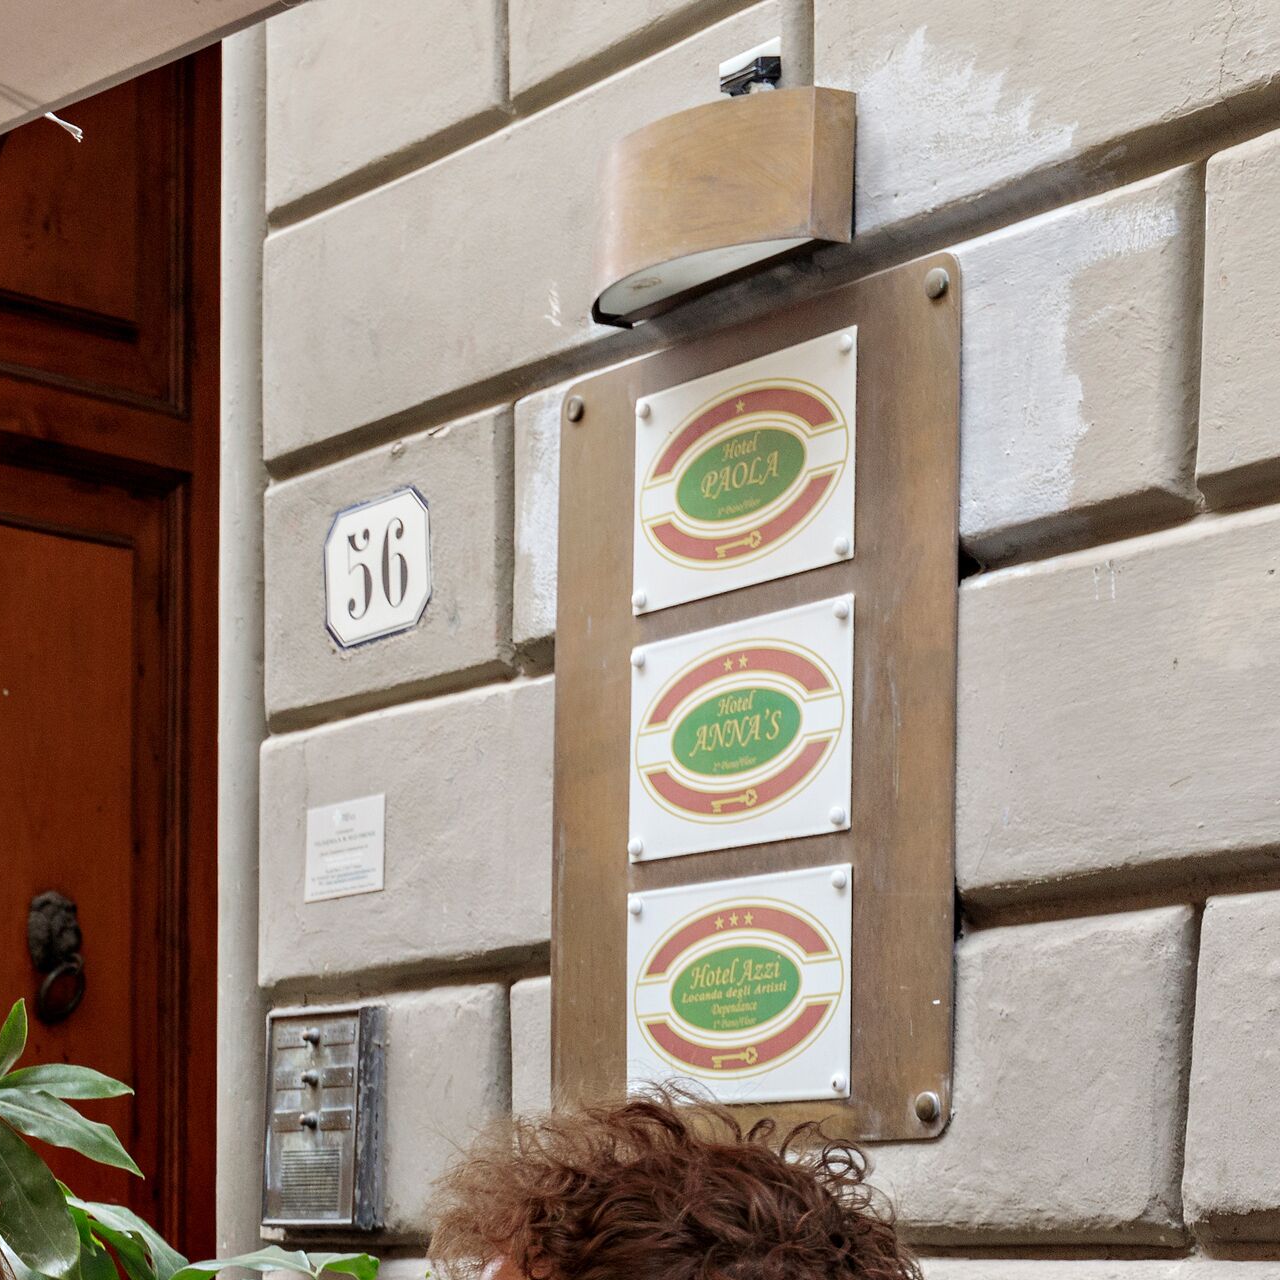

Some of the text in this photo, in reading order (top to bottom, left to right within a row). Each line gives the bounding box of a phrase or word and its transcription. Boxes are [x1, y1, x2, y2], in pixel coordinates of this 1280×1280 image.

[721, 431, 760, 462] Hotel
[701, 450, 779, 500] PAOLA
[347, 517, 408, 620] 56
[717, 689, 757, 717] Hotel
[689, 708, 782, 758] ANNA'S
[690, 955, 782, 990] Hotel Azzi
[682, 980, 787, 1004] Locanda degli Artisti
